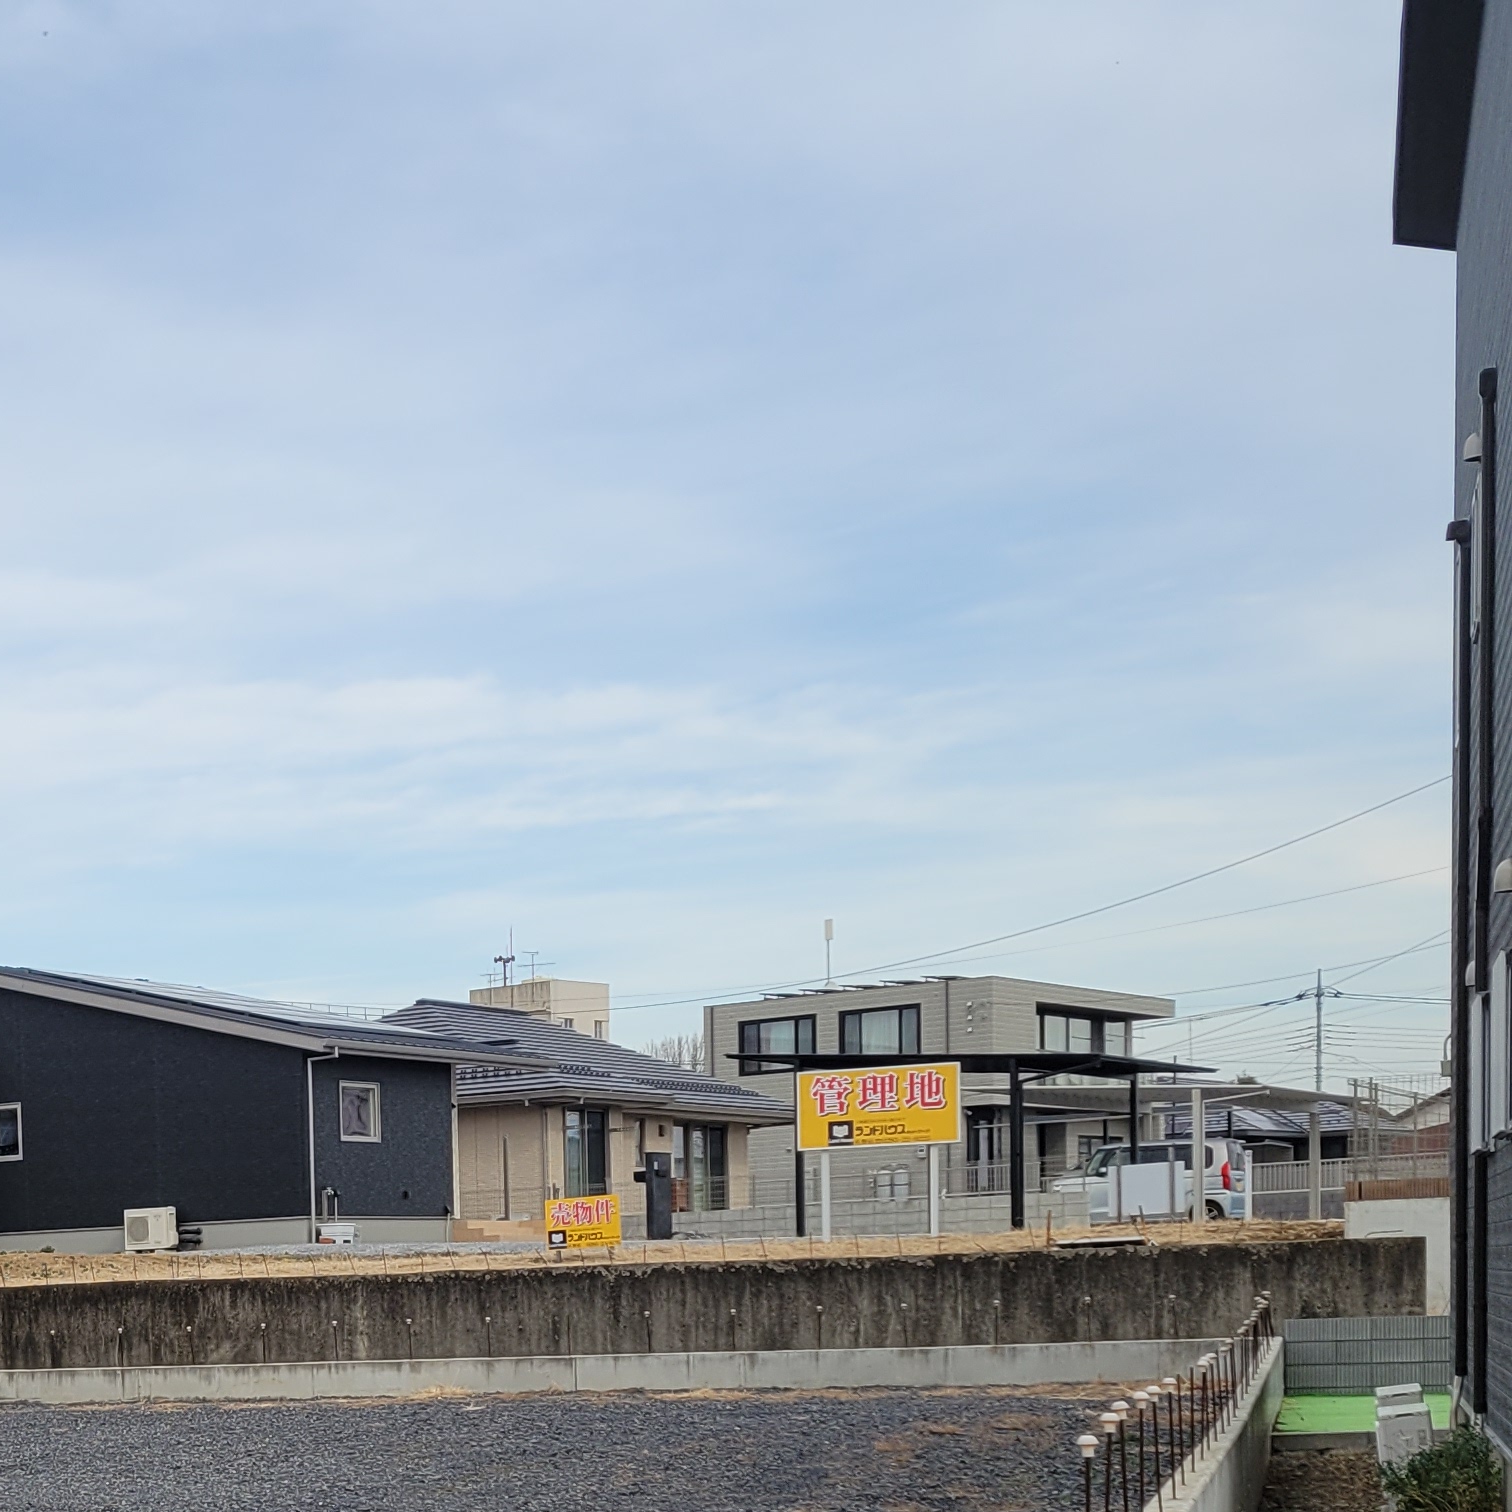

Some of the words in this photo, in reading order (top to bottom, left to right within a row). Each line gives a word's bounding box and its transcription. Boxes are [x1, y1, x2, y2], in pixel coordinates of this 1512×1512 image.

[811, 1070, 946, 1116] 管理地
[855, 1123, 906, 1136] ランドハウス
[550, 1199, 615, 1228] 売物件
